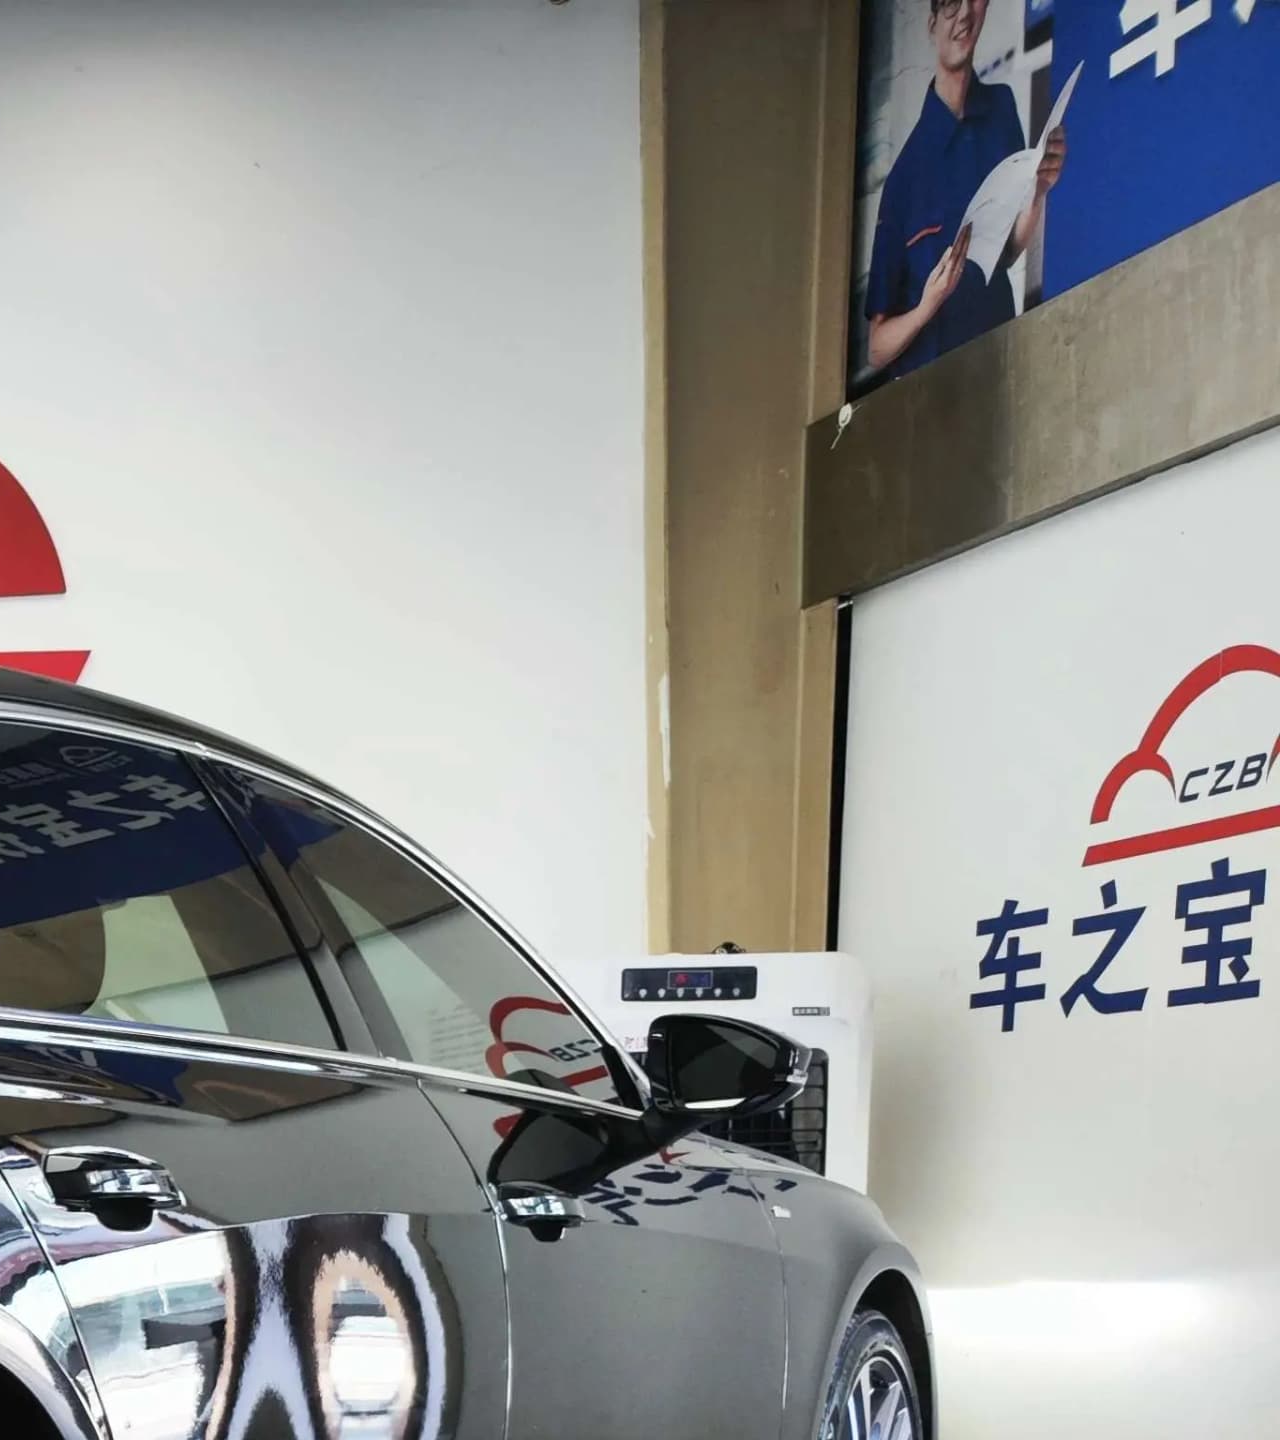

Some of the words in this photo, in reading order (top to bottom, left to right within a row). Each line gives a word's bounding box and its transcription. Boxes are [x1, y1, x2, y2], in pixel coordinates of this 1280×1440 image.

[1178, 752, 1268, 803] CZB
[969, 856, 1267, 1032] 车之宝
